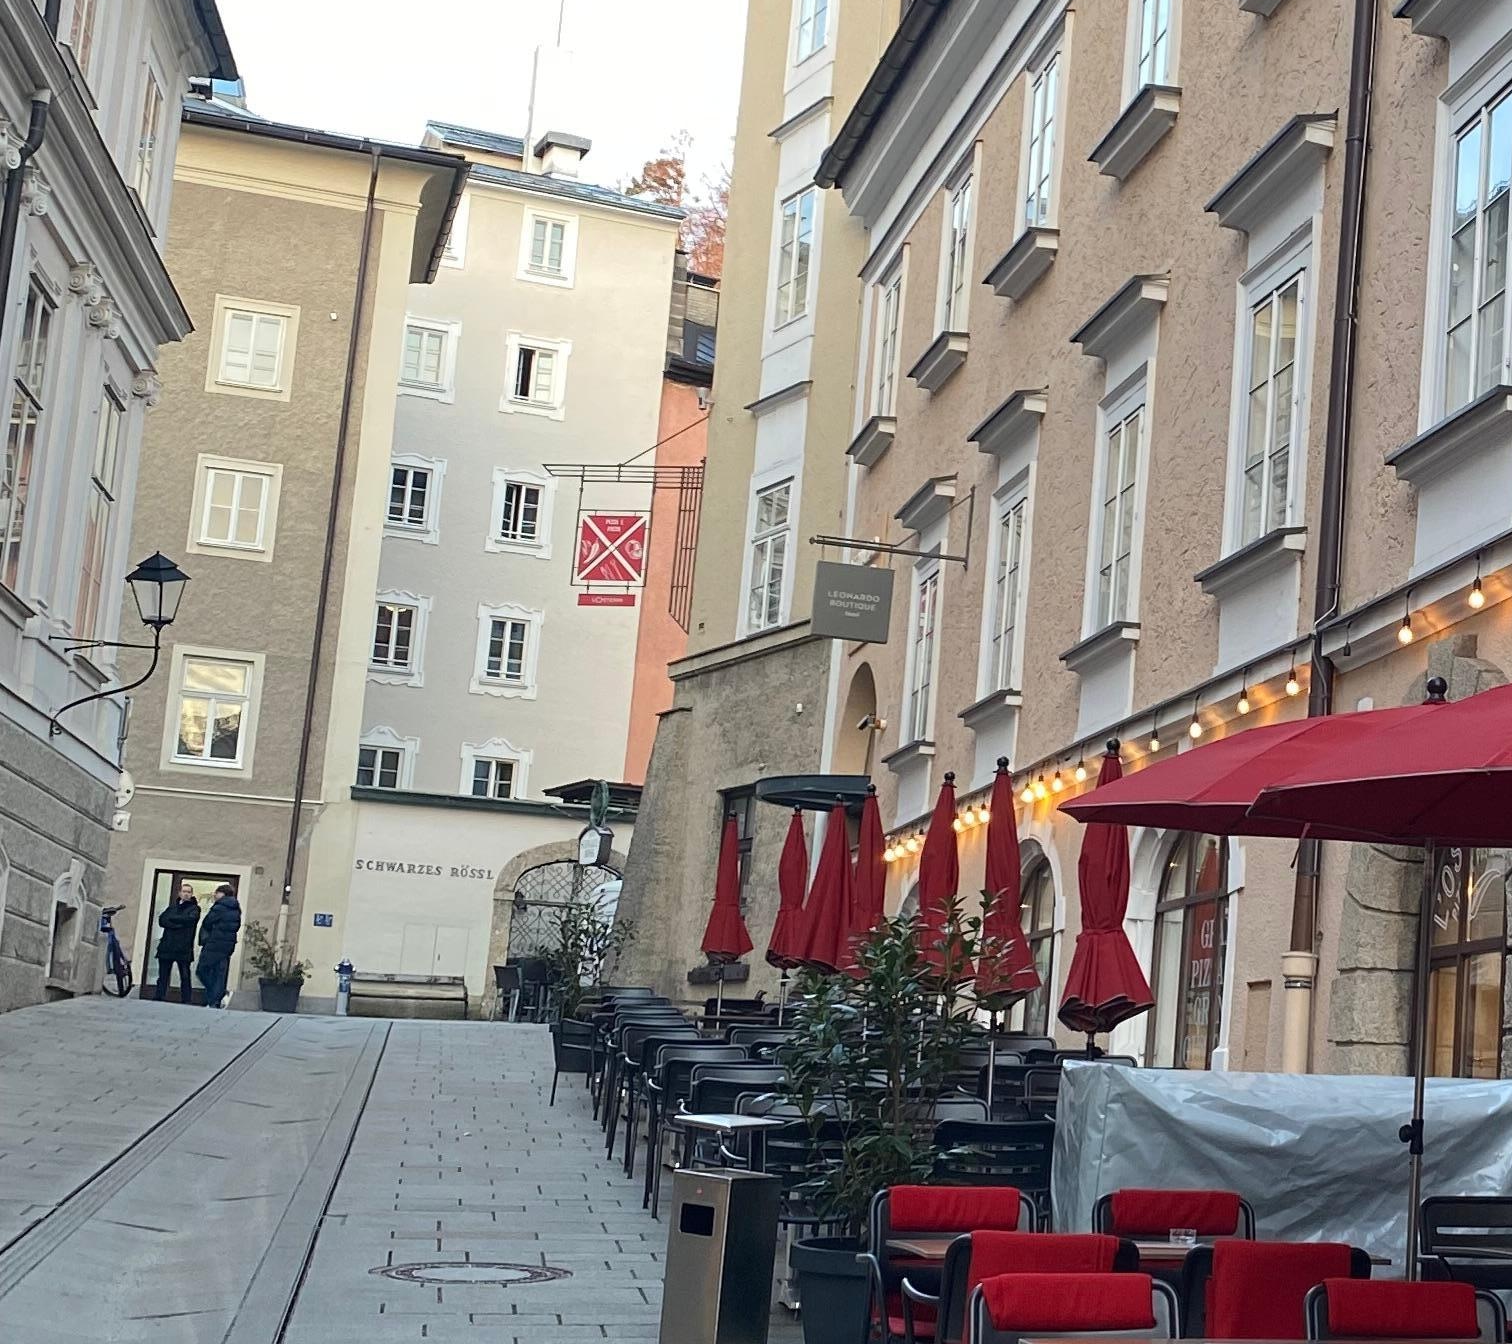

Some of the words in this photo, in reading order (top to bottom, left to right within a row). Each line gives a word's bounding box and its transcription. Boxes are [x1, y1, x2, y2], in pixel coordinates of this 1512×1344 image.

[828, 590, 880, 603] LEONARDO
[355, 859, 443, 876] SCHWARZES
[450, 864, 494, 880] RÖSSL
